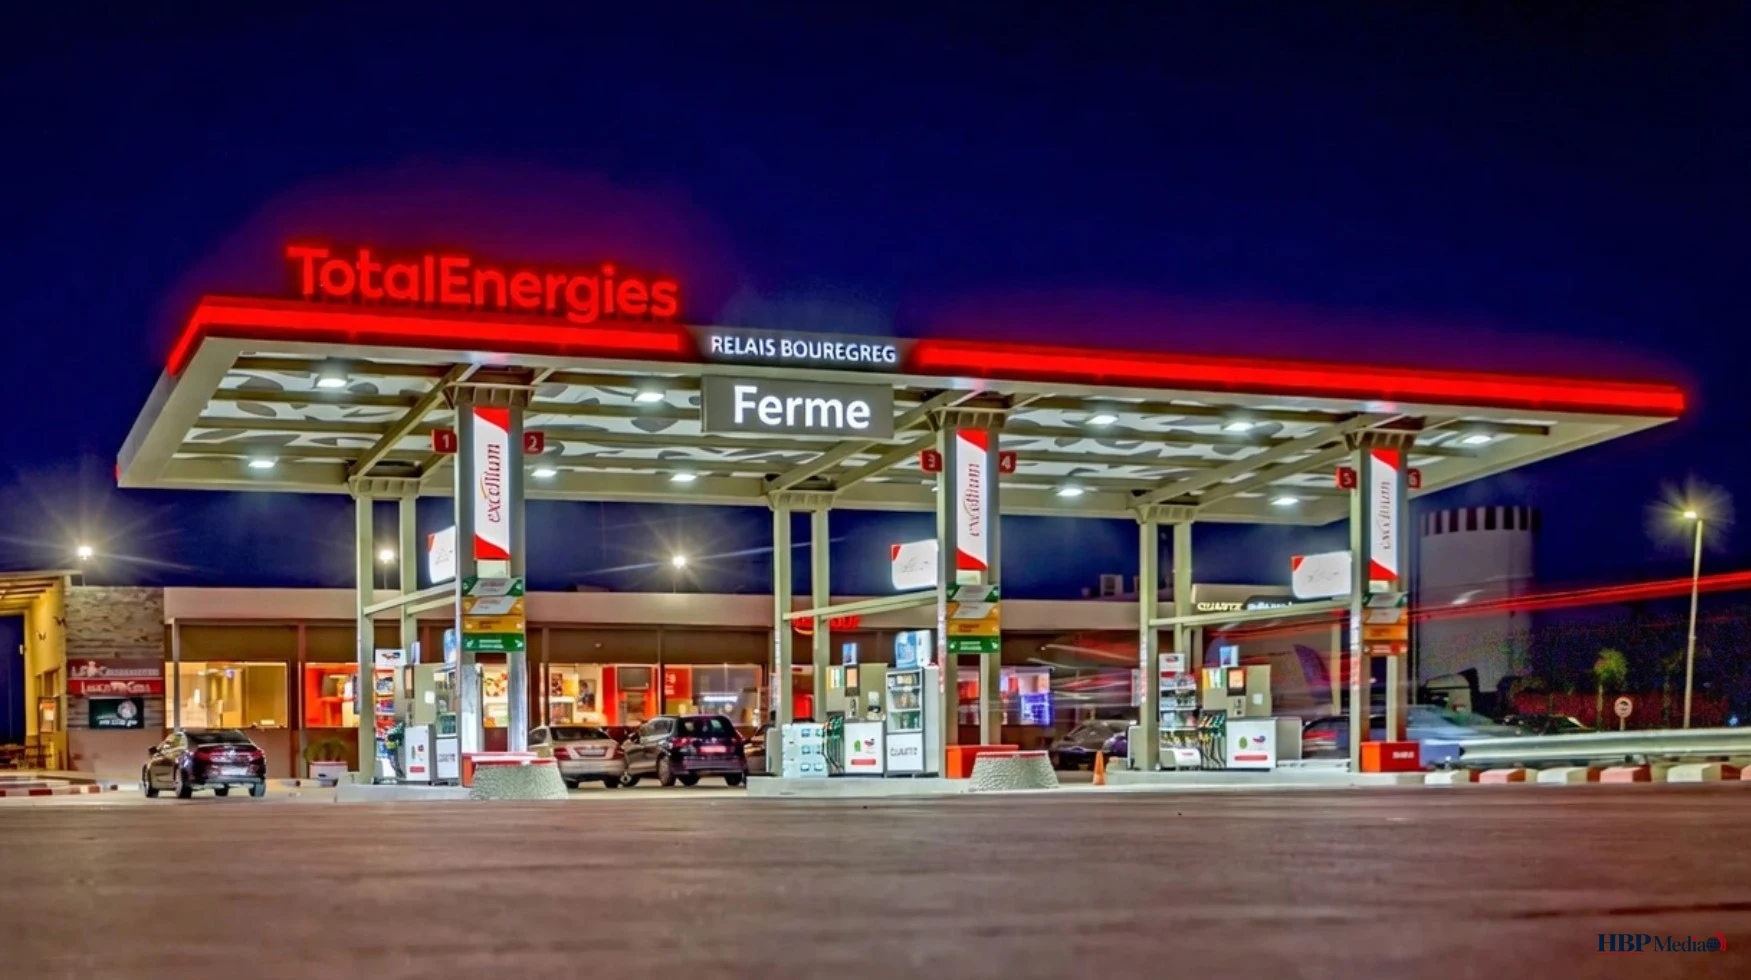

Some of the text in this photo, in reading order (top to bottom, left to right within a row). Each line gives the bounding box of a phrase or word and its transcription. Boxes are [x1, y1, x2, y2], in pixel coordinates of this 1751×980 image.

[286, 246, 679, 323] TotalEnergies
[711, 335, 897, 363] RELAIS BOUREGREG
[733, 384, 871, 430] Ferme
[442, 433, 450, 449] 1
[528, 435, 539, 451] 2
[1001, 455, 1013, 470] 4
[482, 443, 501, 523] excellium
